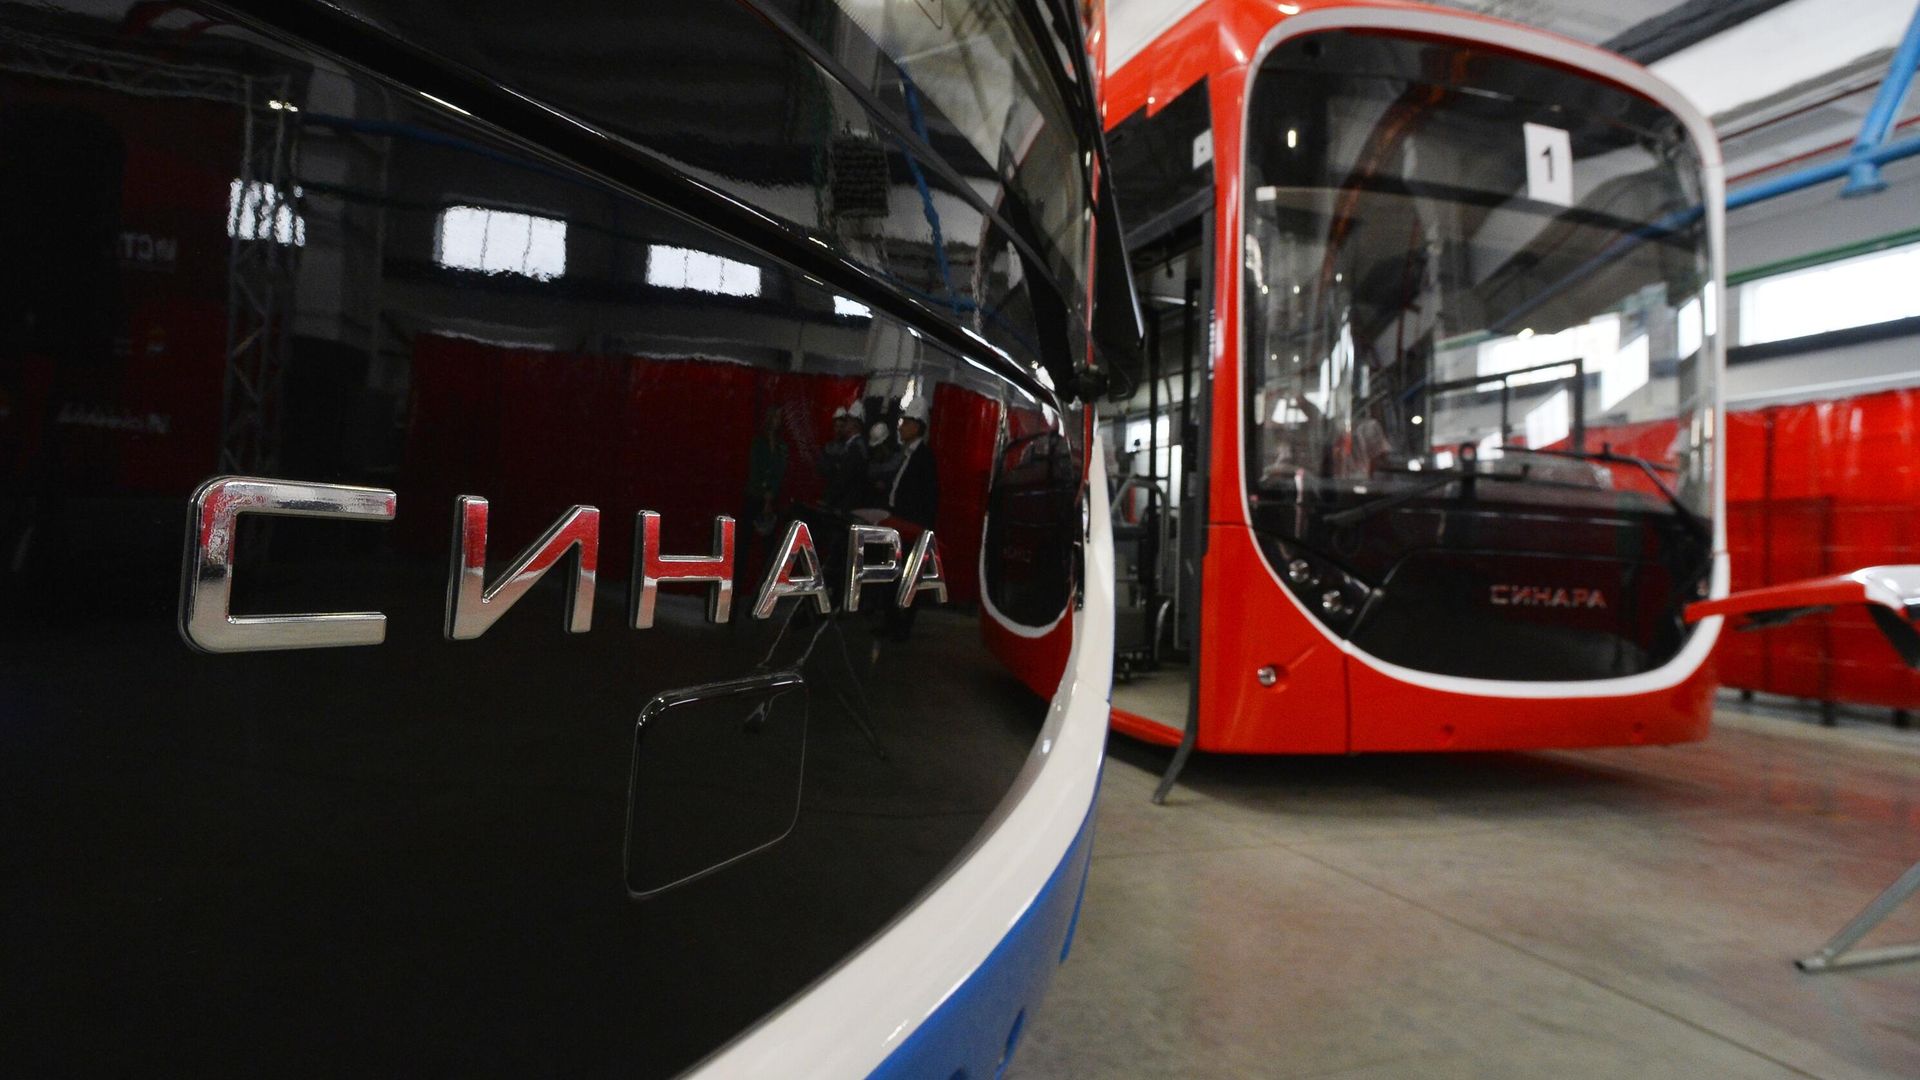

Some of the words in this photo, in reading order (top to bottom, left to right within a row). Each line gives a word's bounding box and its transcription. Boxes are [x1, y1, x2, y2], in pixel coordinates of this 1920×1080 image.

[1541, 145, 1554, 182] 1
[180, 475, 947, 653] СИНАРА
[1490, 585, 1607, 608] СИНАРА
